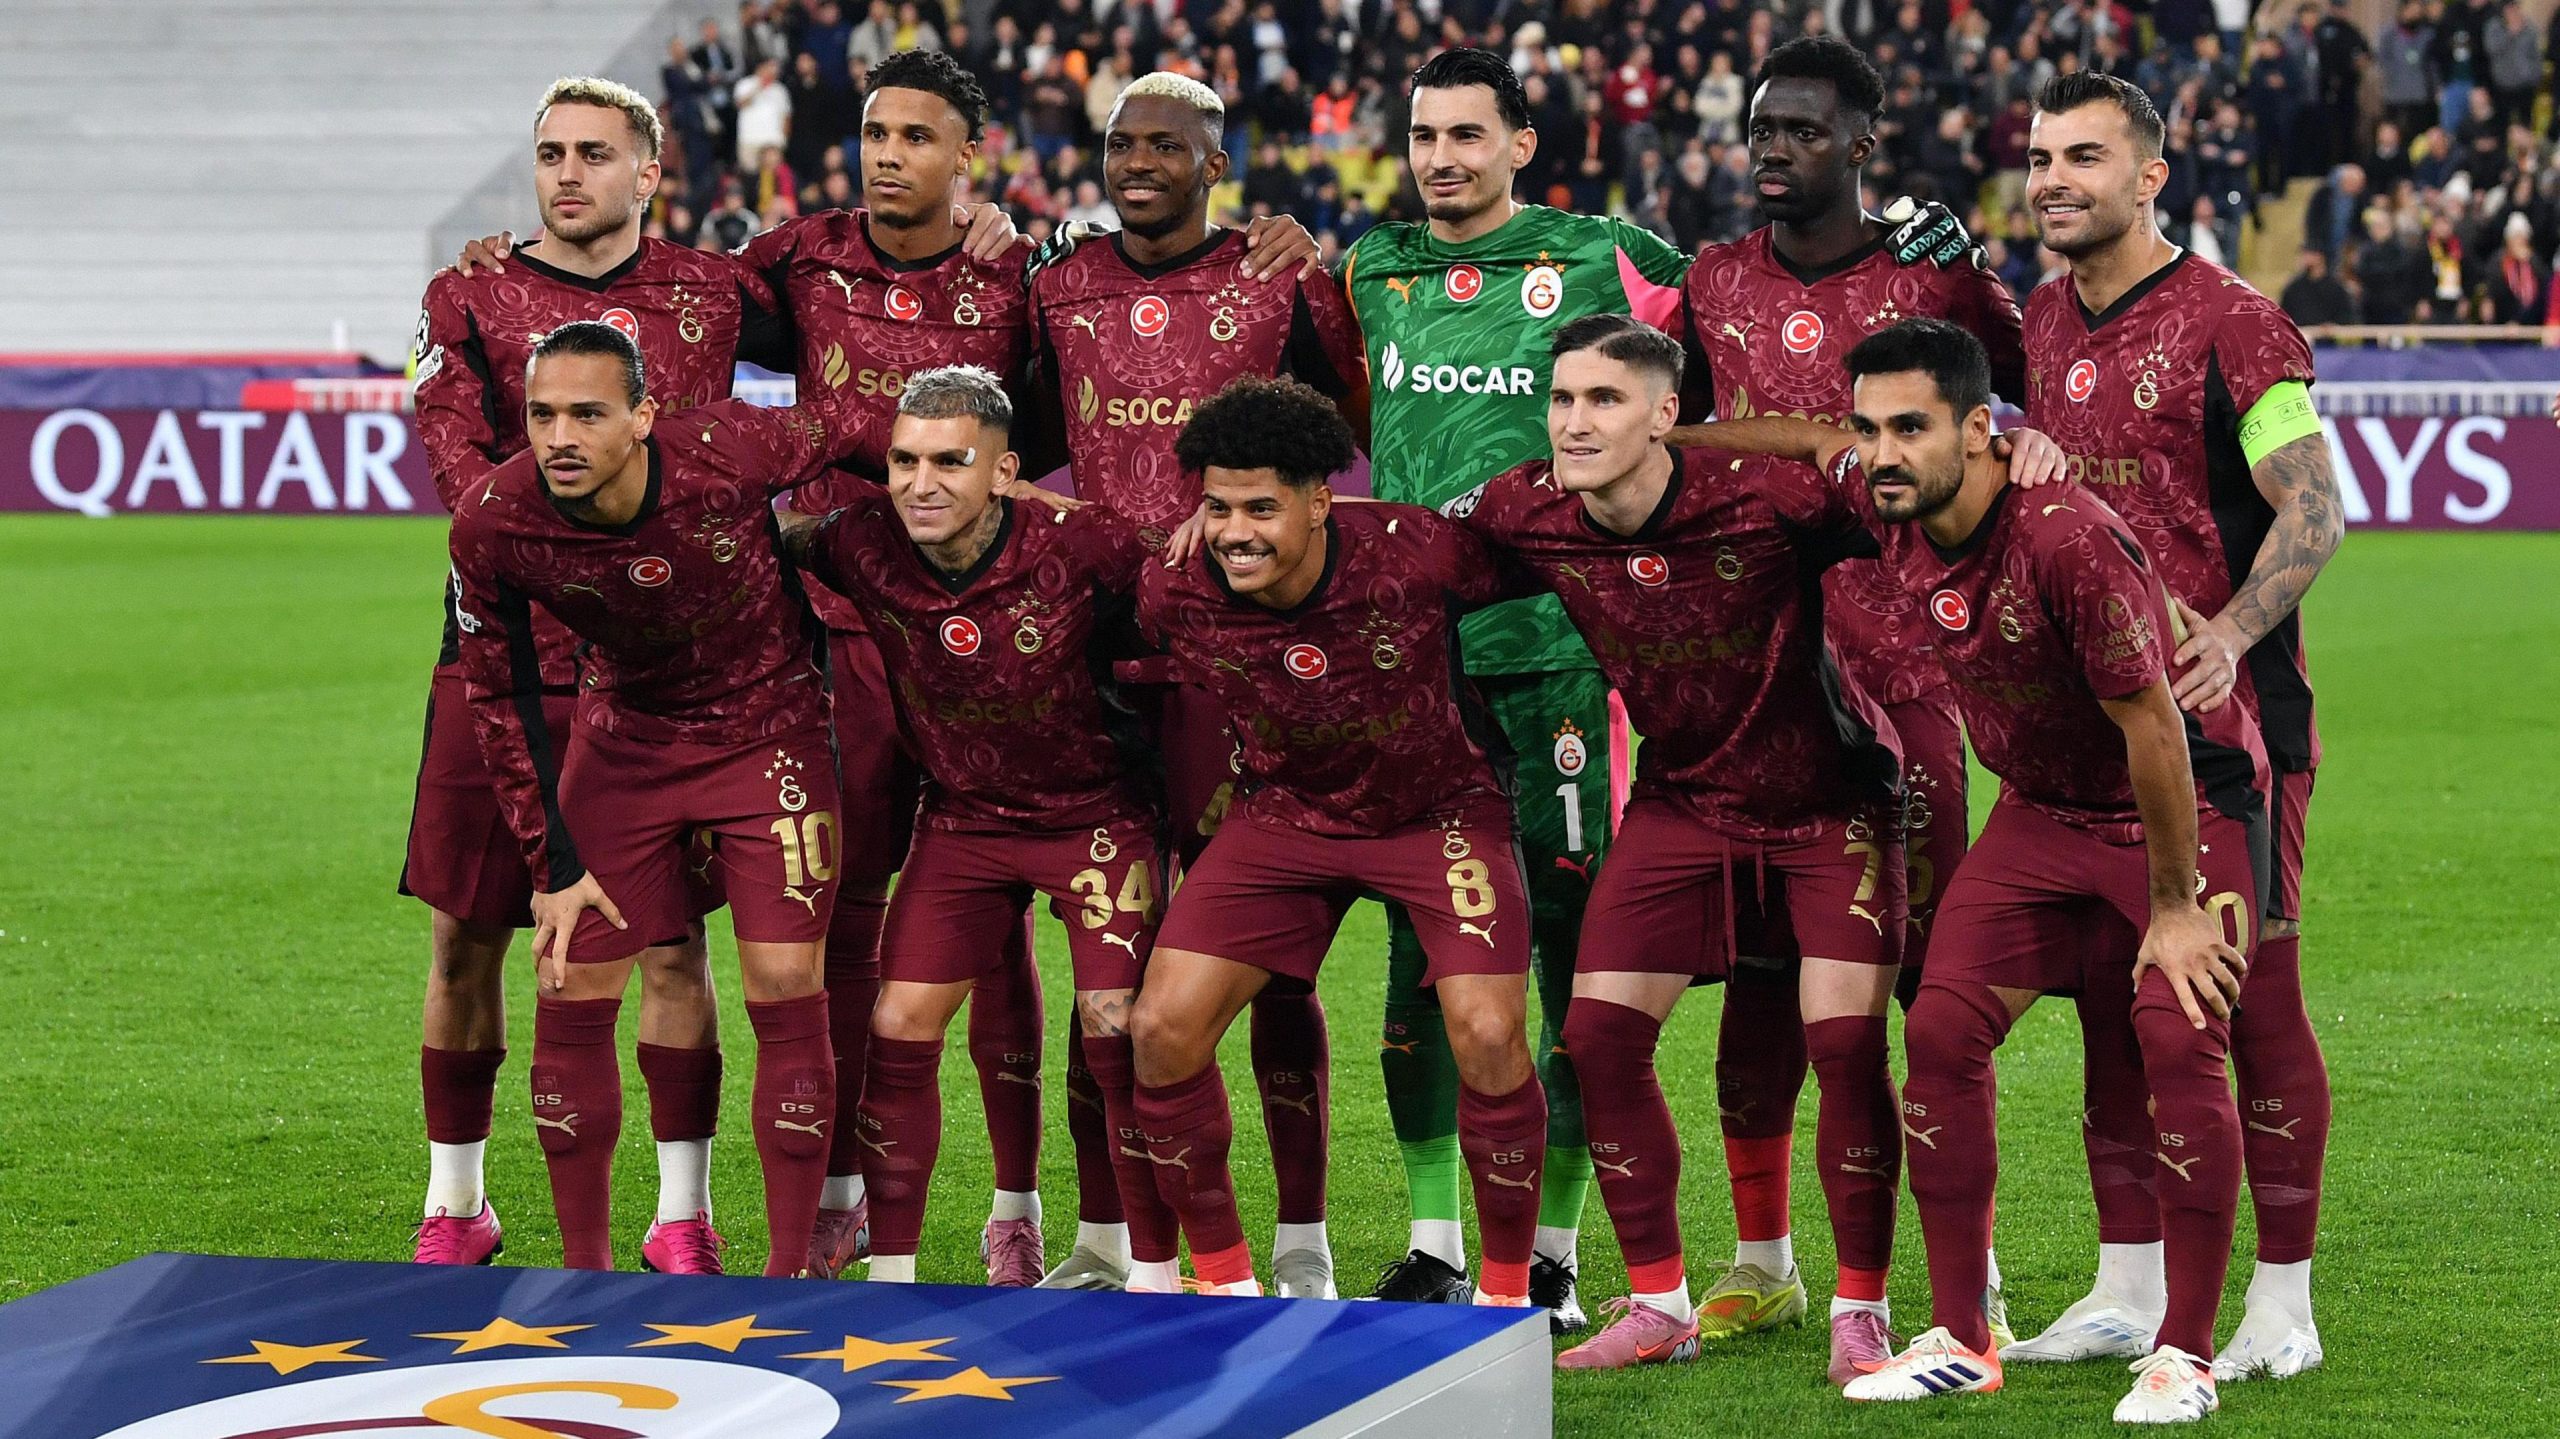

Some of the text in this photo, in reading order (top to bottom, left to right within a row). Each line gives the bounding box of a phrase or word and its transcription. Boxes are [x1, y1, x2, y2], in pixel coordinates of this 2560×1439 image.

[1896, 207, 1930, 246] ONE
[1410, 364, 1534, 395] SOCAR
[1106, 397, 1194, 426] SOCA
[29, 408, 414, 516] QATAR
[2067, 456, 2141, 487] OCAR
[2095, 613, 2148, 649] TURKISH
[1634, 627, 1759, 666] SOCAR
[1289, 708, 1411, 746] SOCAR
[1555, 782, 1585, 852] 1
[770, 810, 839, 887] 10
[1843, 841, 1881, 902] 7
[1070, 859, 1157, 929] 34
[1446, 858, 1497, 917] 8
[2204, 890, 2249, 957] 0
[1383, 1021, 1409, 1035] GS
[1003, 1053, 1034, 1063] GS
[1273, 1071, 1302, 1084] GS
[534, 1094, 562, 1105] GS
[781, 1102, 815, 1114] GS
[1903, 1101, 1927, 1117] GS
[2251, 1098, 2283, 1112] GS
[857, 1111, 882, 1130] GS
[1591, 1142, 1621, 1153] GS
[1846, 1146, 1879, 1158] GS
[2160, 1132, 2185, 1148] GS
[1492, 1149, 1525, 1164] GS
